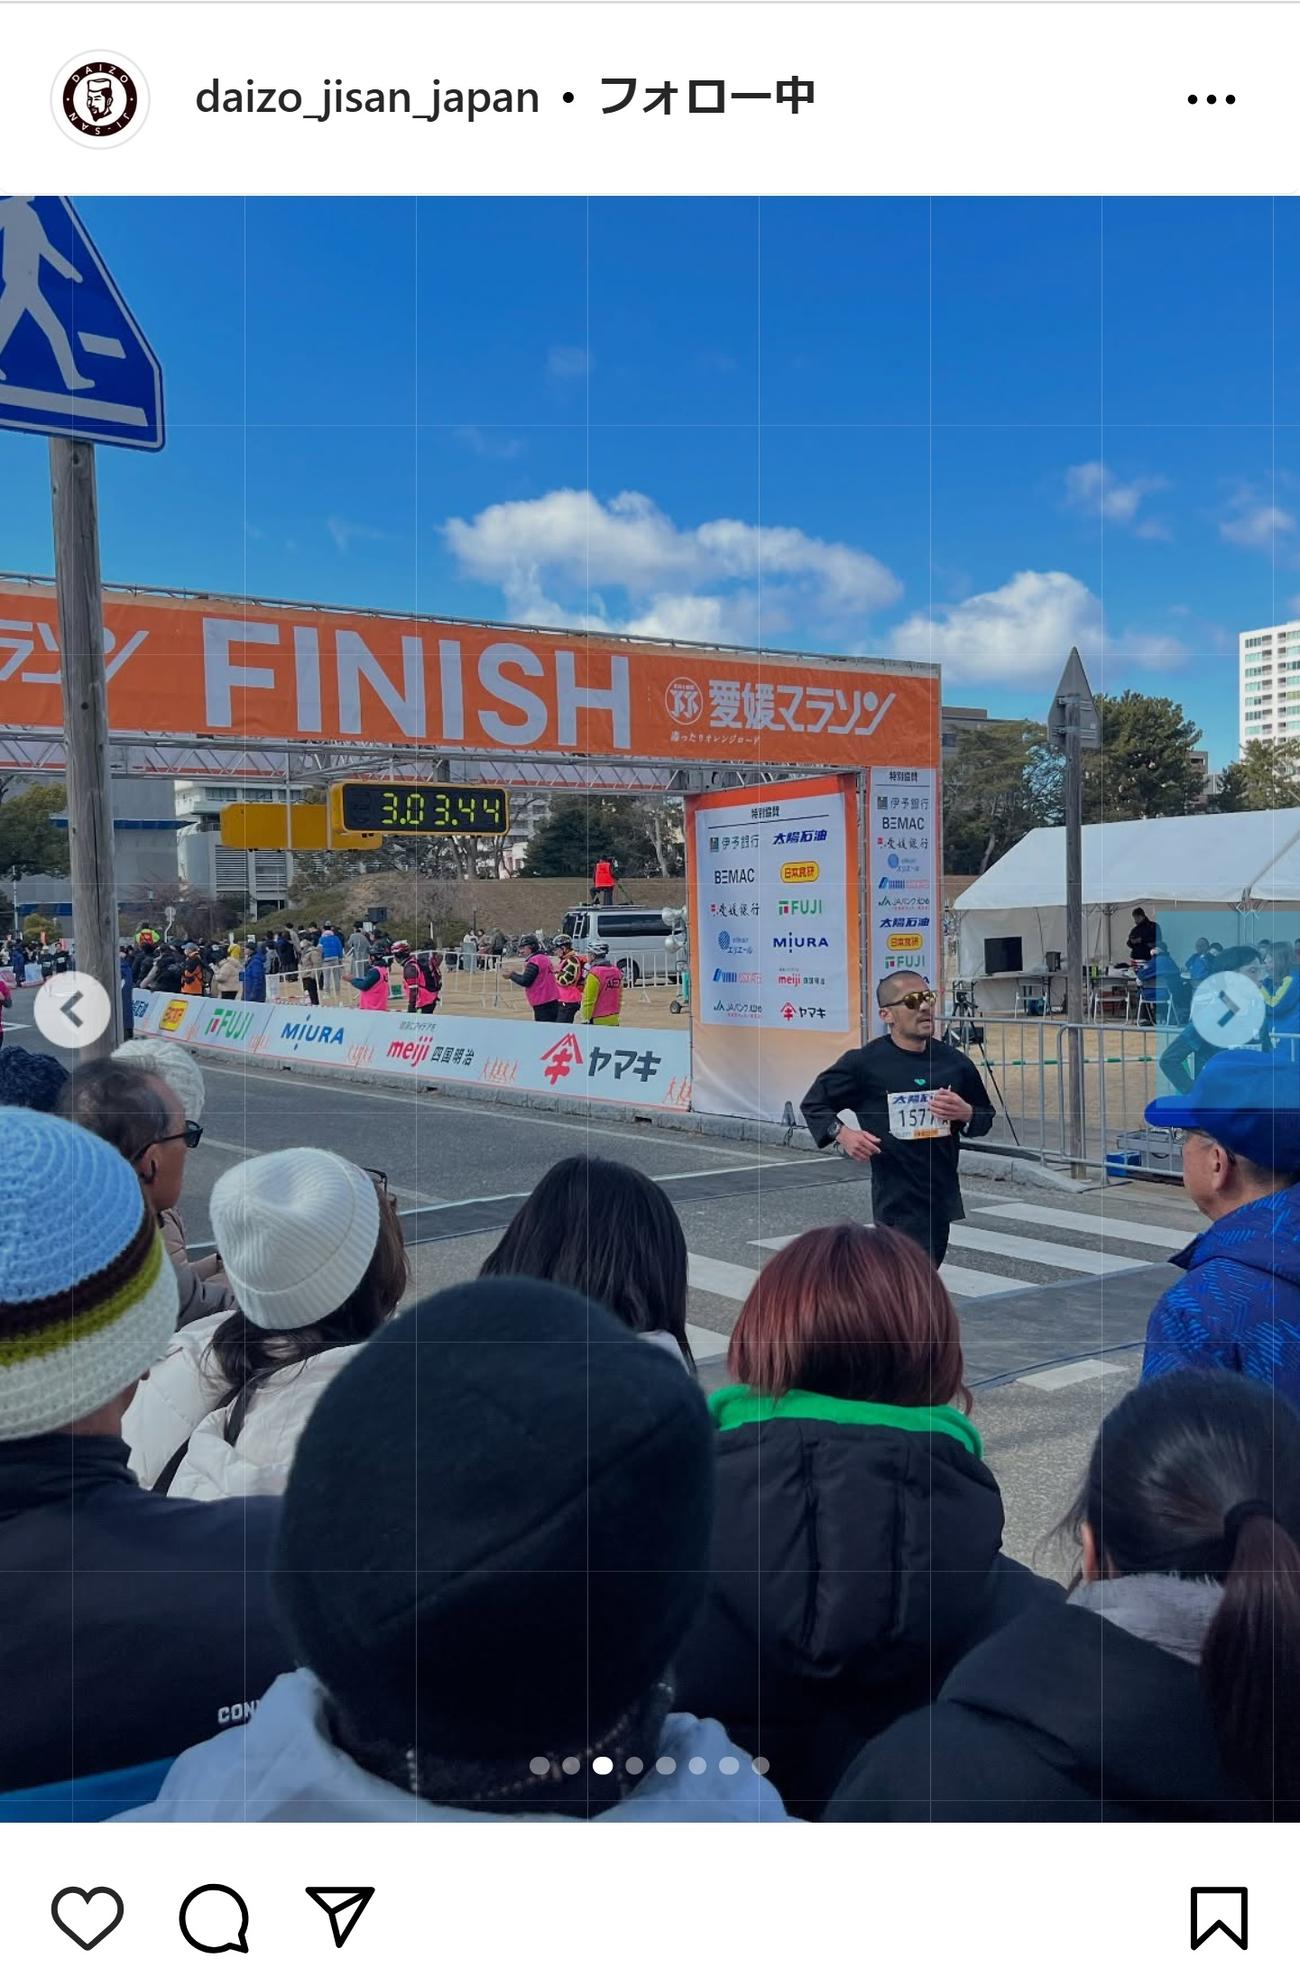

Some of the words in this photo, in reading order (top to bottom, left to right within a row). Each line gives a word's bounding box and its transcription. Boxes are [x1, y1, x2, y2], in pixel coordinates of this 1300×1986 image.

[203, 617, 632, 749] FINISH
[708, 679, 897, 736] 愛媛マラソン
[882, 816, 925, 830] BEMAC
[772, 829, 828, 845] 太陽石油
[714, 868, 756, 885] BEMAC
[791, 899, 823, 915] FUJI
[896, 955, 926, 968] FUJI
[778, 973, 801, 988] meiji
[799, 1006, 827, 1019] ヤマキ
[220, 1010, 255, 1041] FUJI
[386, 1035, 434, 1068] meiji
[588, 1046, 662, 1083] ヤマキ
[218, 1700, 261, 1724] CON
